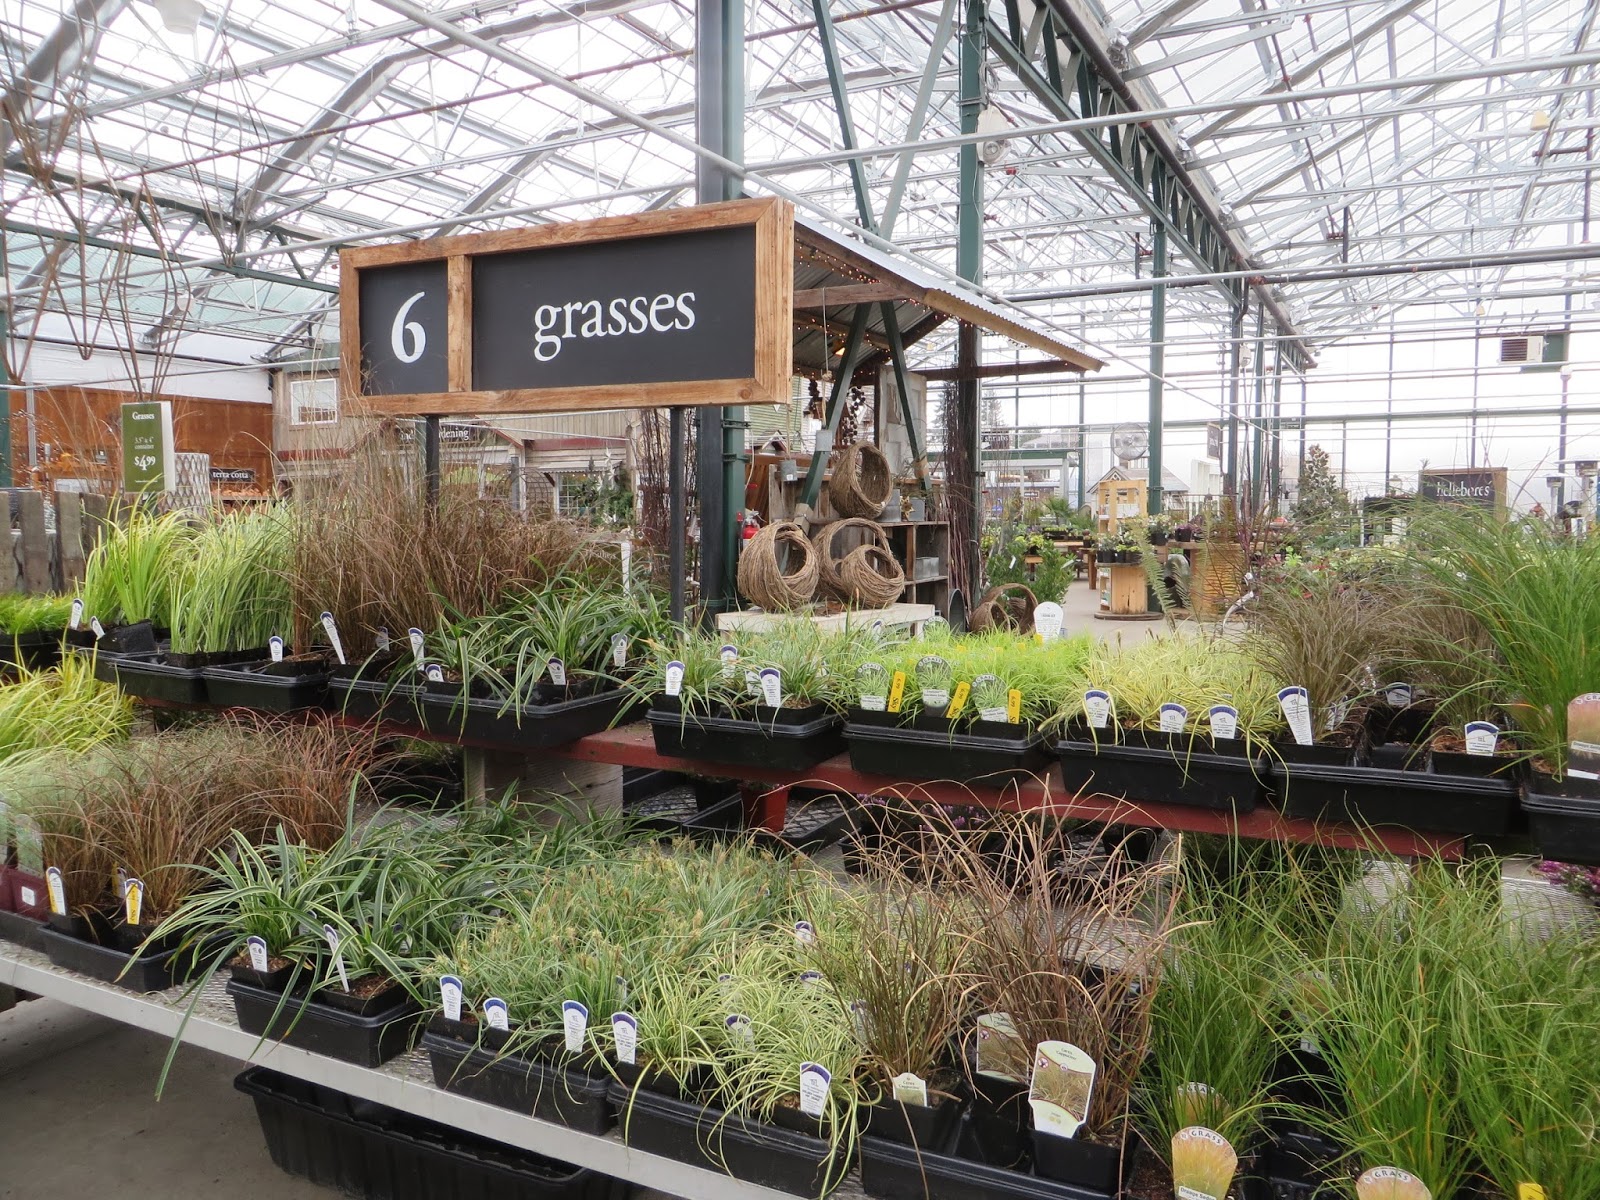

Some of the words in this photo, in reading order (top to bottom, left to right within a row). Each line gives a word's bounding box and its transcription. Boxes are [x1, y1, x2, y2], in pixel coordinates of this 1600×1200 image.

[391, 291, 427, 364] 6
[533, 291, 696, 363] grasses
[132, 411, 155, 420] Grasses
[213, 471, 230, 479] terra
[1191, 1130, 1222, 1145] GRASS
[1374, 1169, 1409, 1181] GRASS
